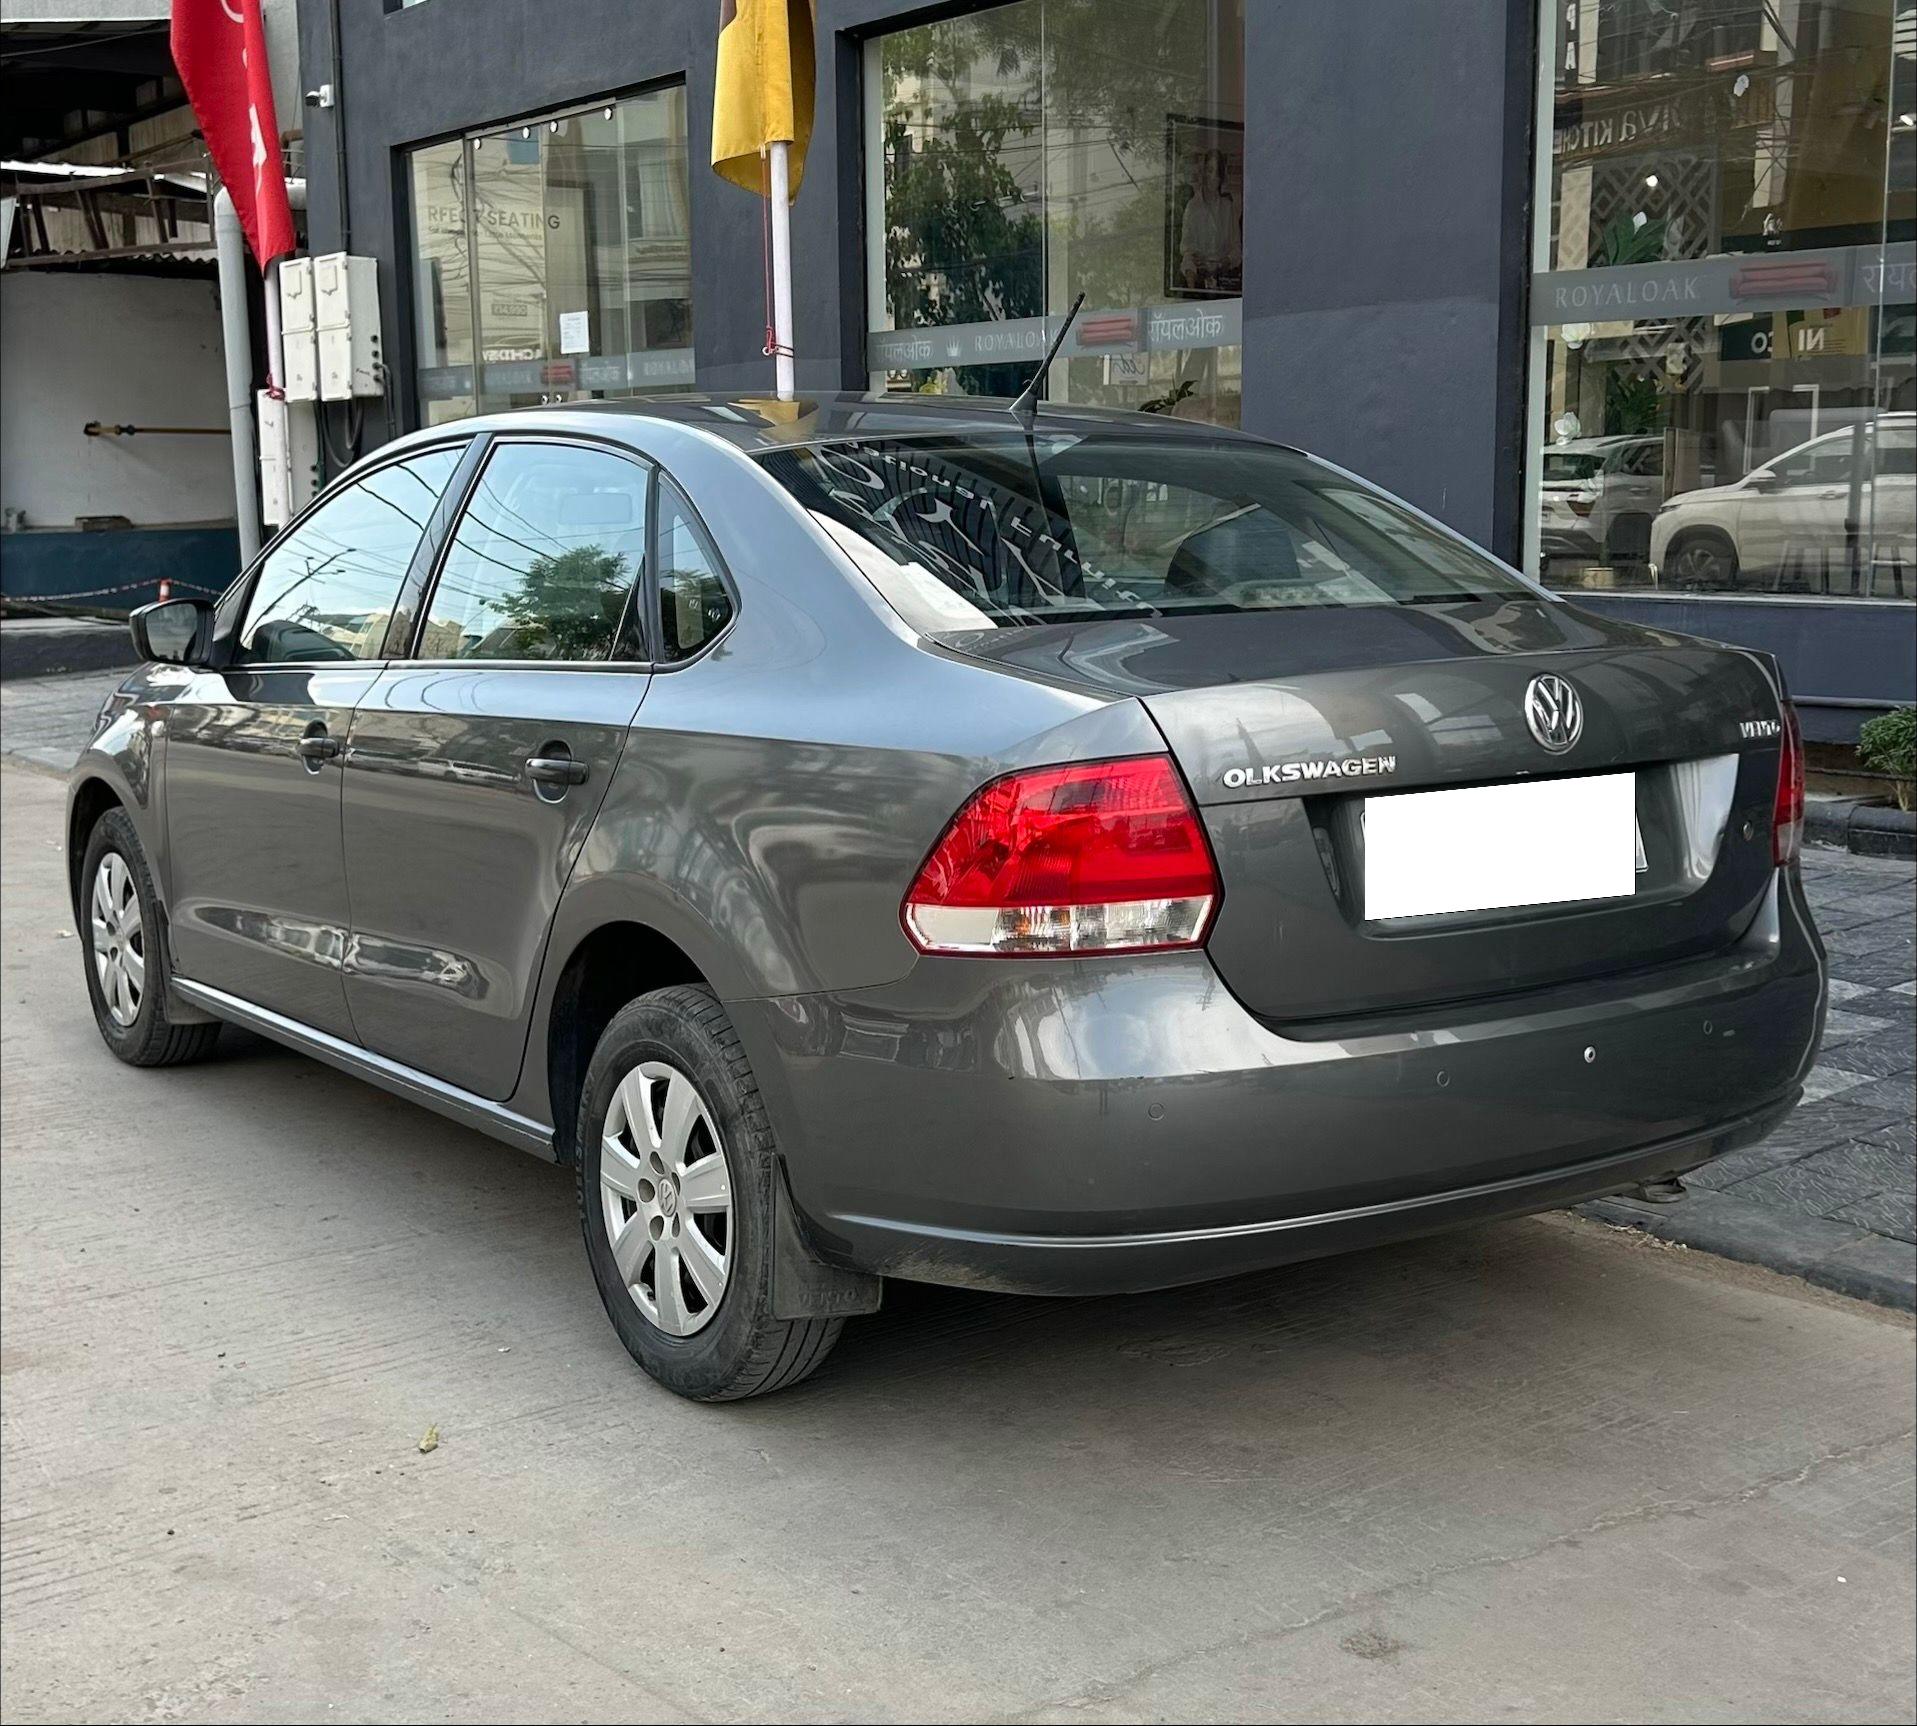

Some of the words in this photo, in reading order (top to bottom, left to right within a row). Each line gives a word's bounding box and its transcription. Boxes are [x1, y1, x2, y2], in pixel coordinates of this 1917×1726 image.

[487, 209, 561, 230] SEATING
[1555, 275, 1700, 309] ROYALOAK
[1222, 755, 1397, 789] OLKSWAGEN
